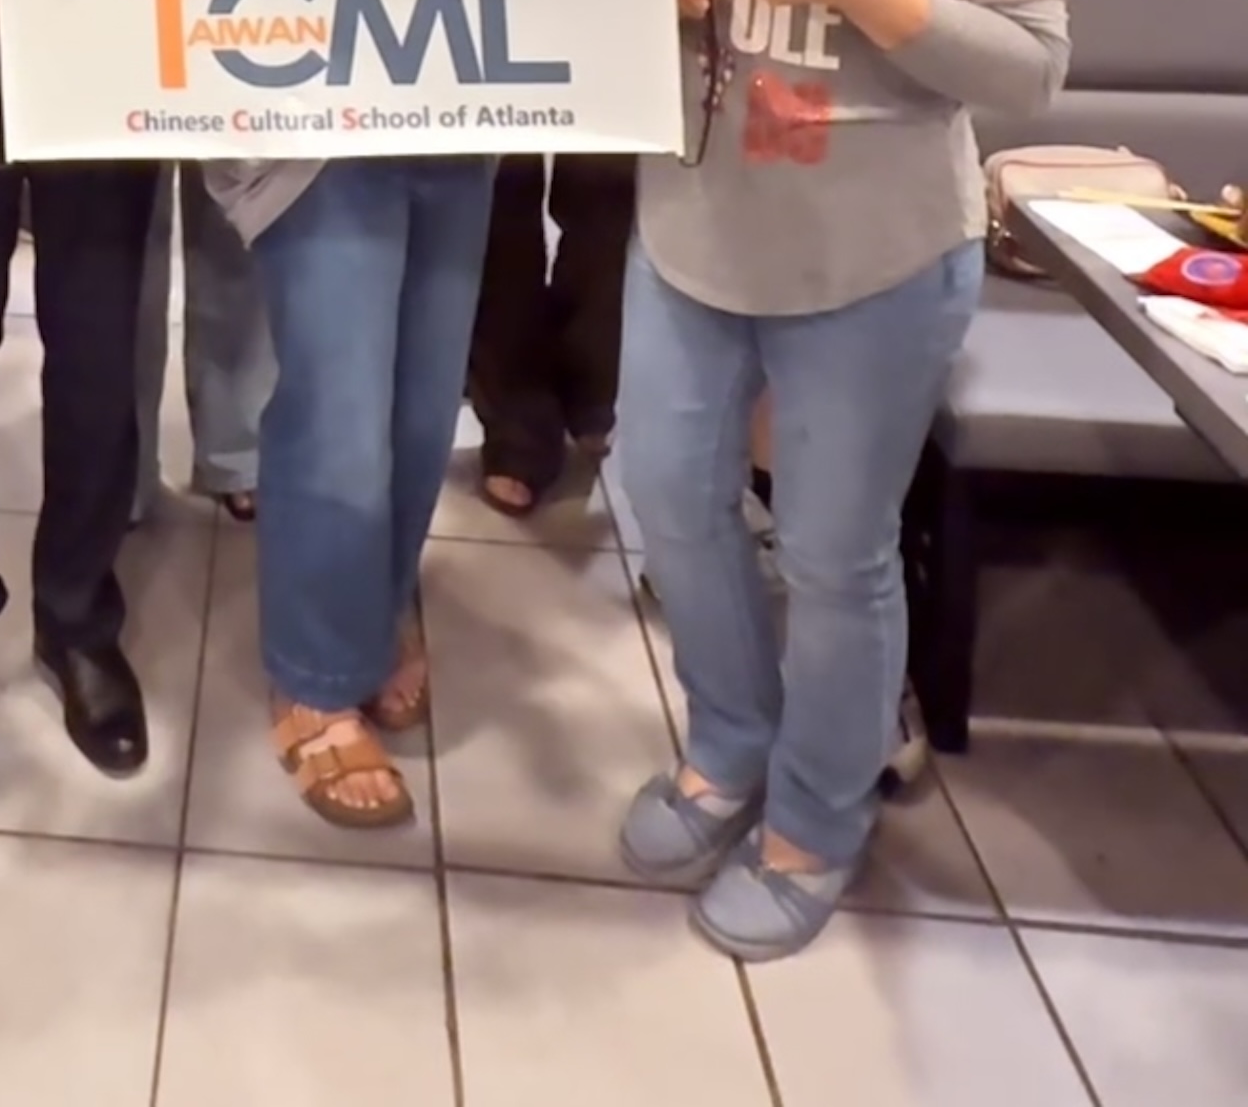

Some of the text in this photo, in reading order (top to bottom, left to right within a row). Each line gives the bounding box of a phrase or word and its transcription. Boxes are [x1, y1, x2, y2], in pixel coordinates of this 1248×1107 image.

[126, 103, 575, 133] Chinese Cultural School of Atlanta
